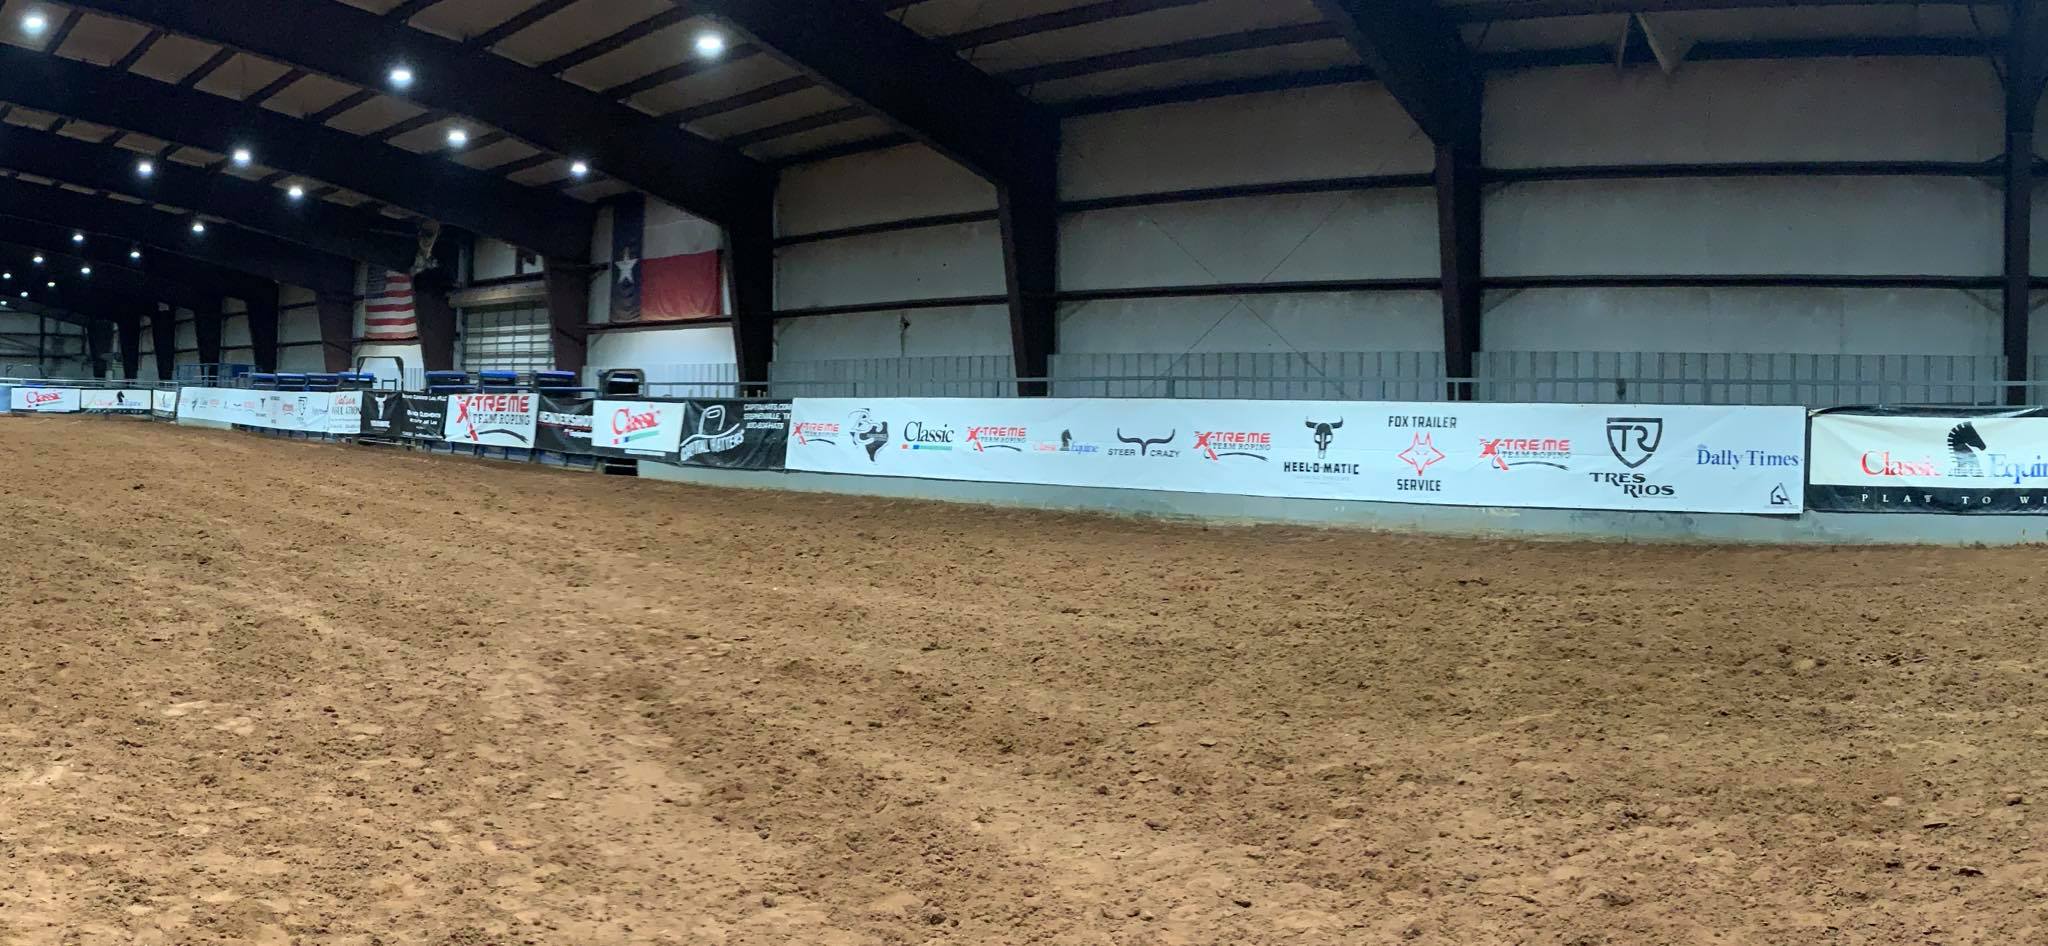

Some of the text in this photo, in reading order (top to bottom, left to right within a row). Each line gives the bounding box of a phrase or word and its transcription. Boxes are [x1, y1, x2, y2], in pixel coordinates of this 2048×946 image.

[456, 395, 529, 424] X-TREME
[473, 413, 498, 424] TEAM
[499, 414, 531, 425] ROPING
[1388, 416, 1457, 429] FOX TRAILER
[903, 421, 955, 443] Classic
[965, 427, 1027, 443] X-TREME
[1193, 431, 1272, 449] X-TREME
[1107, 448, 1180, 458] STEER CRAZY
[1478, 438, 1571, 459] X-TREME
[1501, 451, 1572, 459] TEAM ROPING
[1696, 449, 1799, 470] Dally Times
[1860, 450, 1942, 477] Classic
[1284, 461, 1360, 475] HEEL-O-MATIC
[1396, 478, 1442, 492] SERVICE
[1589, 472, 1646, 486] TRES
[1623, 484, 1675, 498] RIOS
[1861, 494, 1933, 503] PLAY
[1961, 496, 1992, 504] TO
